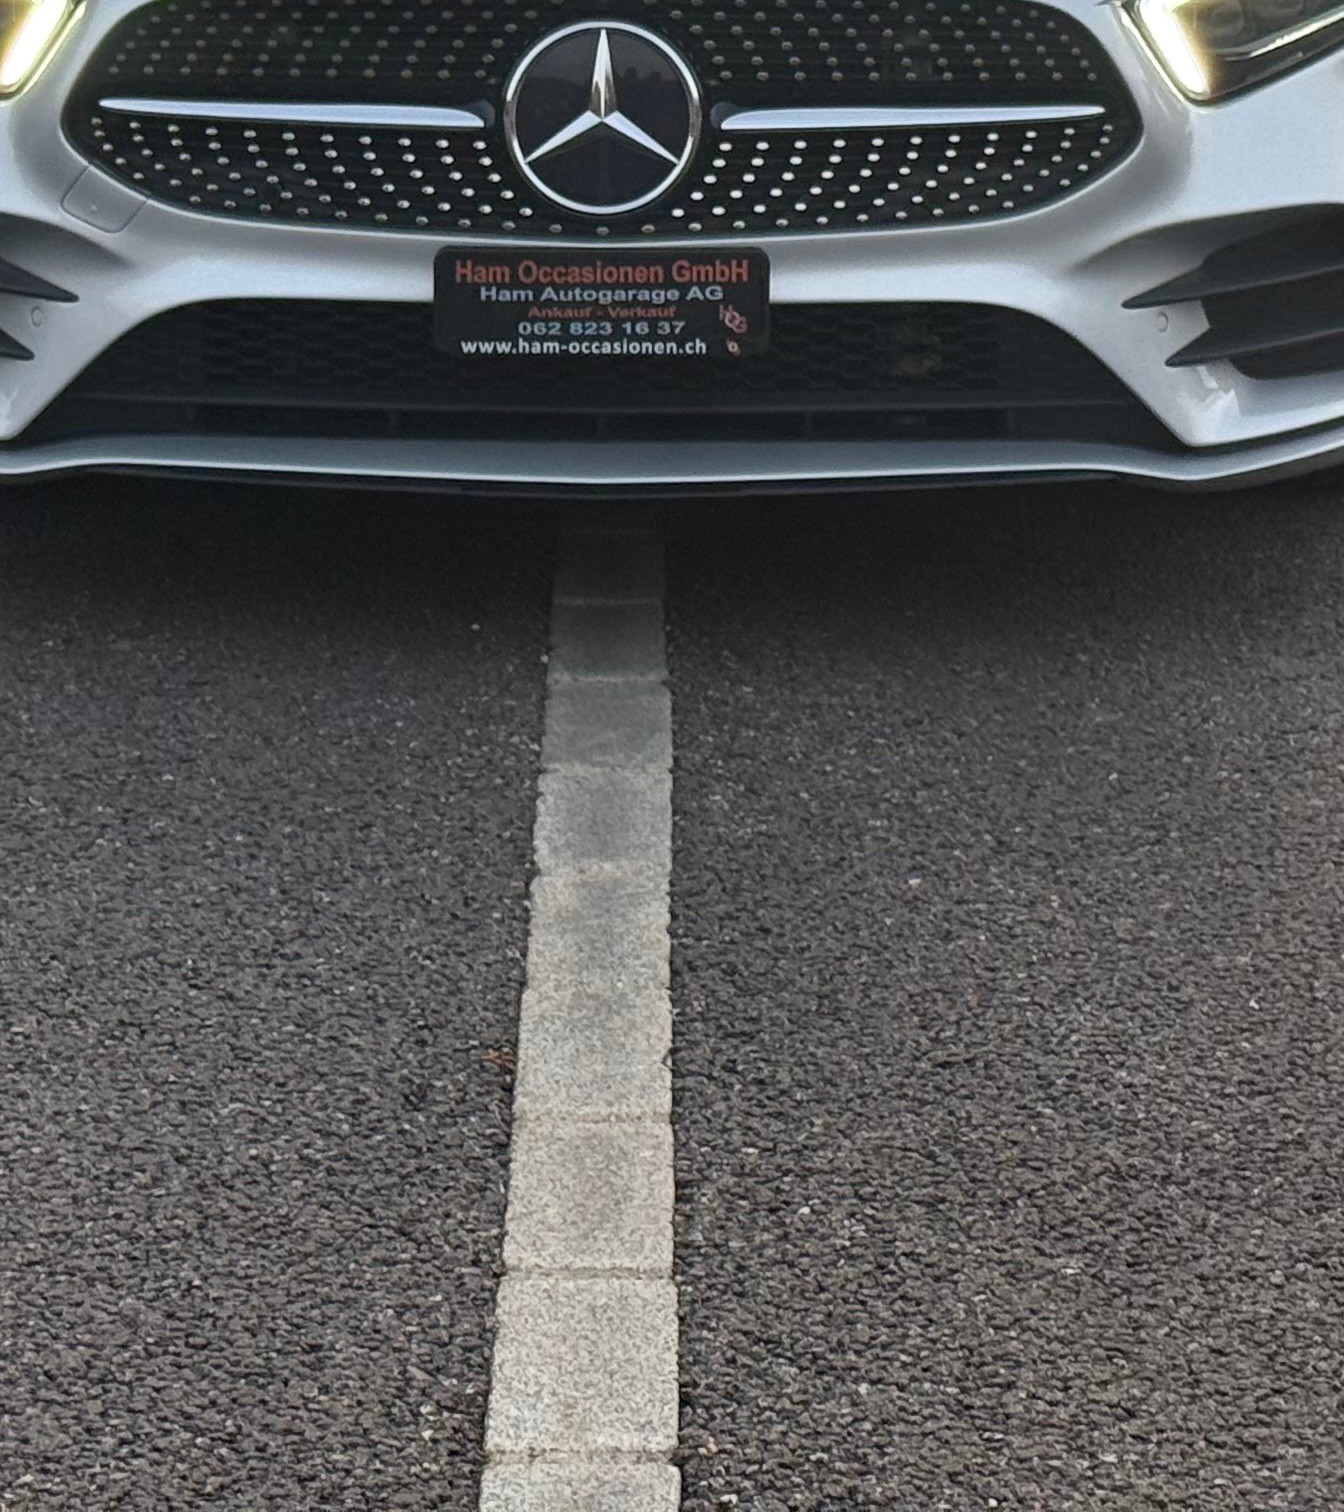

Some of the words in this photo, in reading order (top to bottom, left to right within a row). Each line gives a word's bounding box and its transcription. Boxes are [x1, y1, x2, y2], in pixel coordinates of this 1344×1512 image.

[455, 260, 511, 284] Ham
[518, 259, 665, 284] Occasionen
[671, 259, 749, 283] GmbH
[480, 285, 534, 302] Ham
[540, 285, 680, 305] Autogarage
[686, 285, 724, 301] AG
[528, 306, 592, 319] Ankauf
[608, 305, 678, 318] Verkauf
[518, 321, 562, 335] 062
[569, 321, 613, 335] 823
[622, 321, 650, 335] 16
[657, 321, 686, 335] 37
[460, 337, 707, 355] www.ham-occasionen.ch
